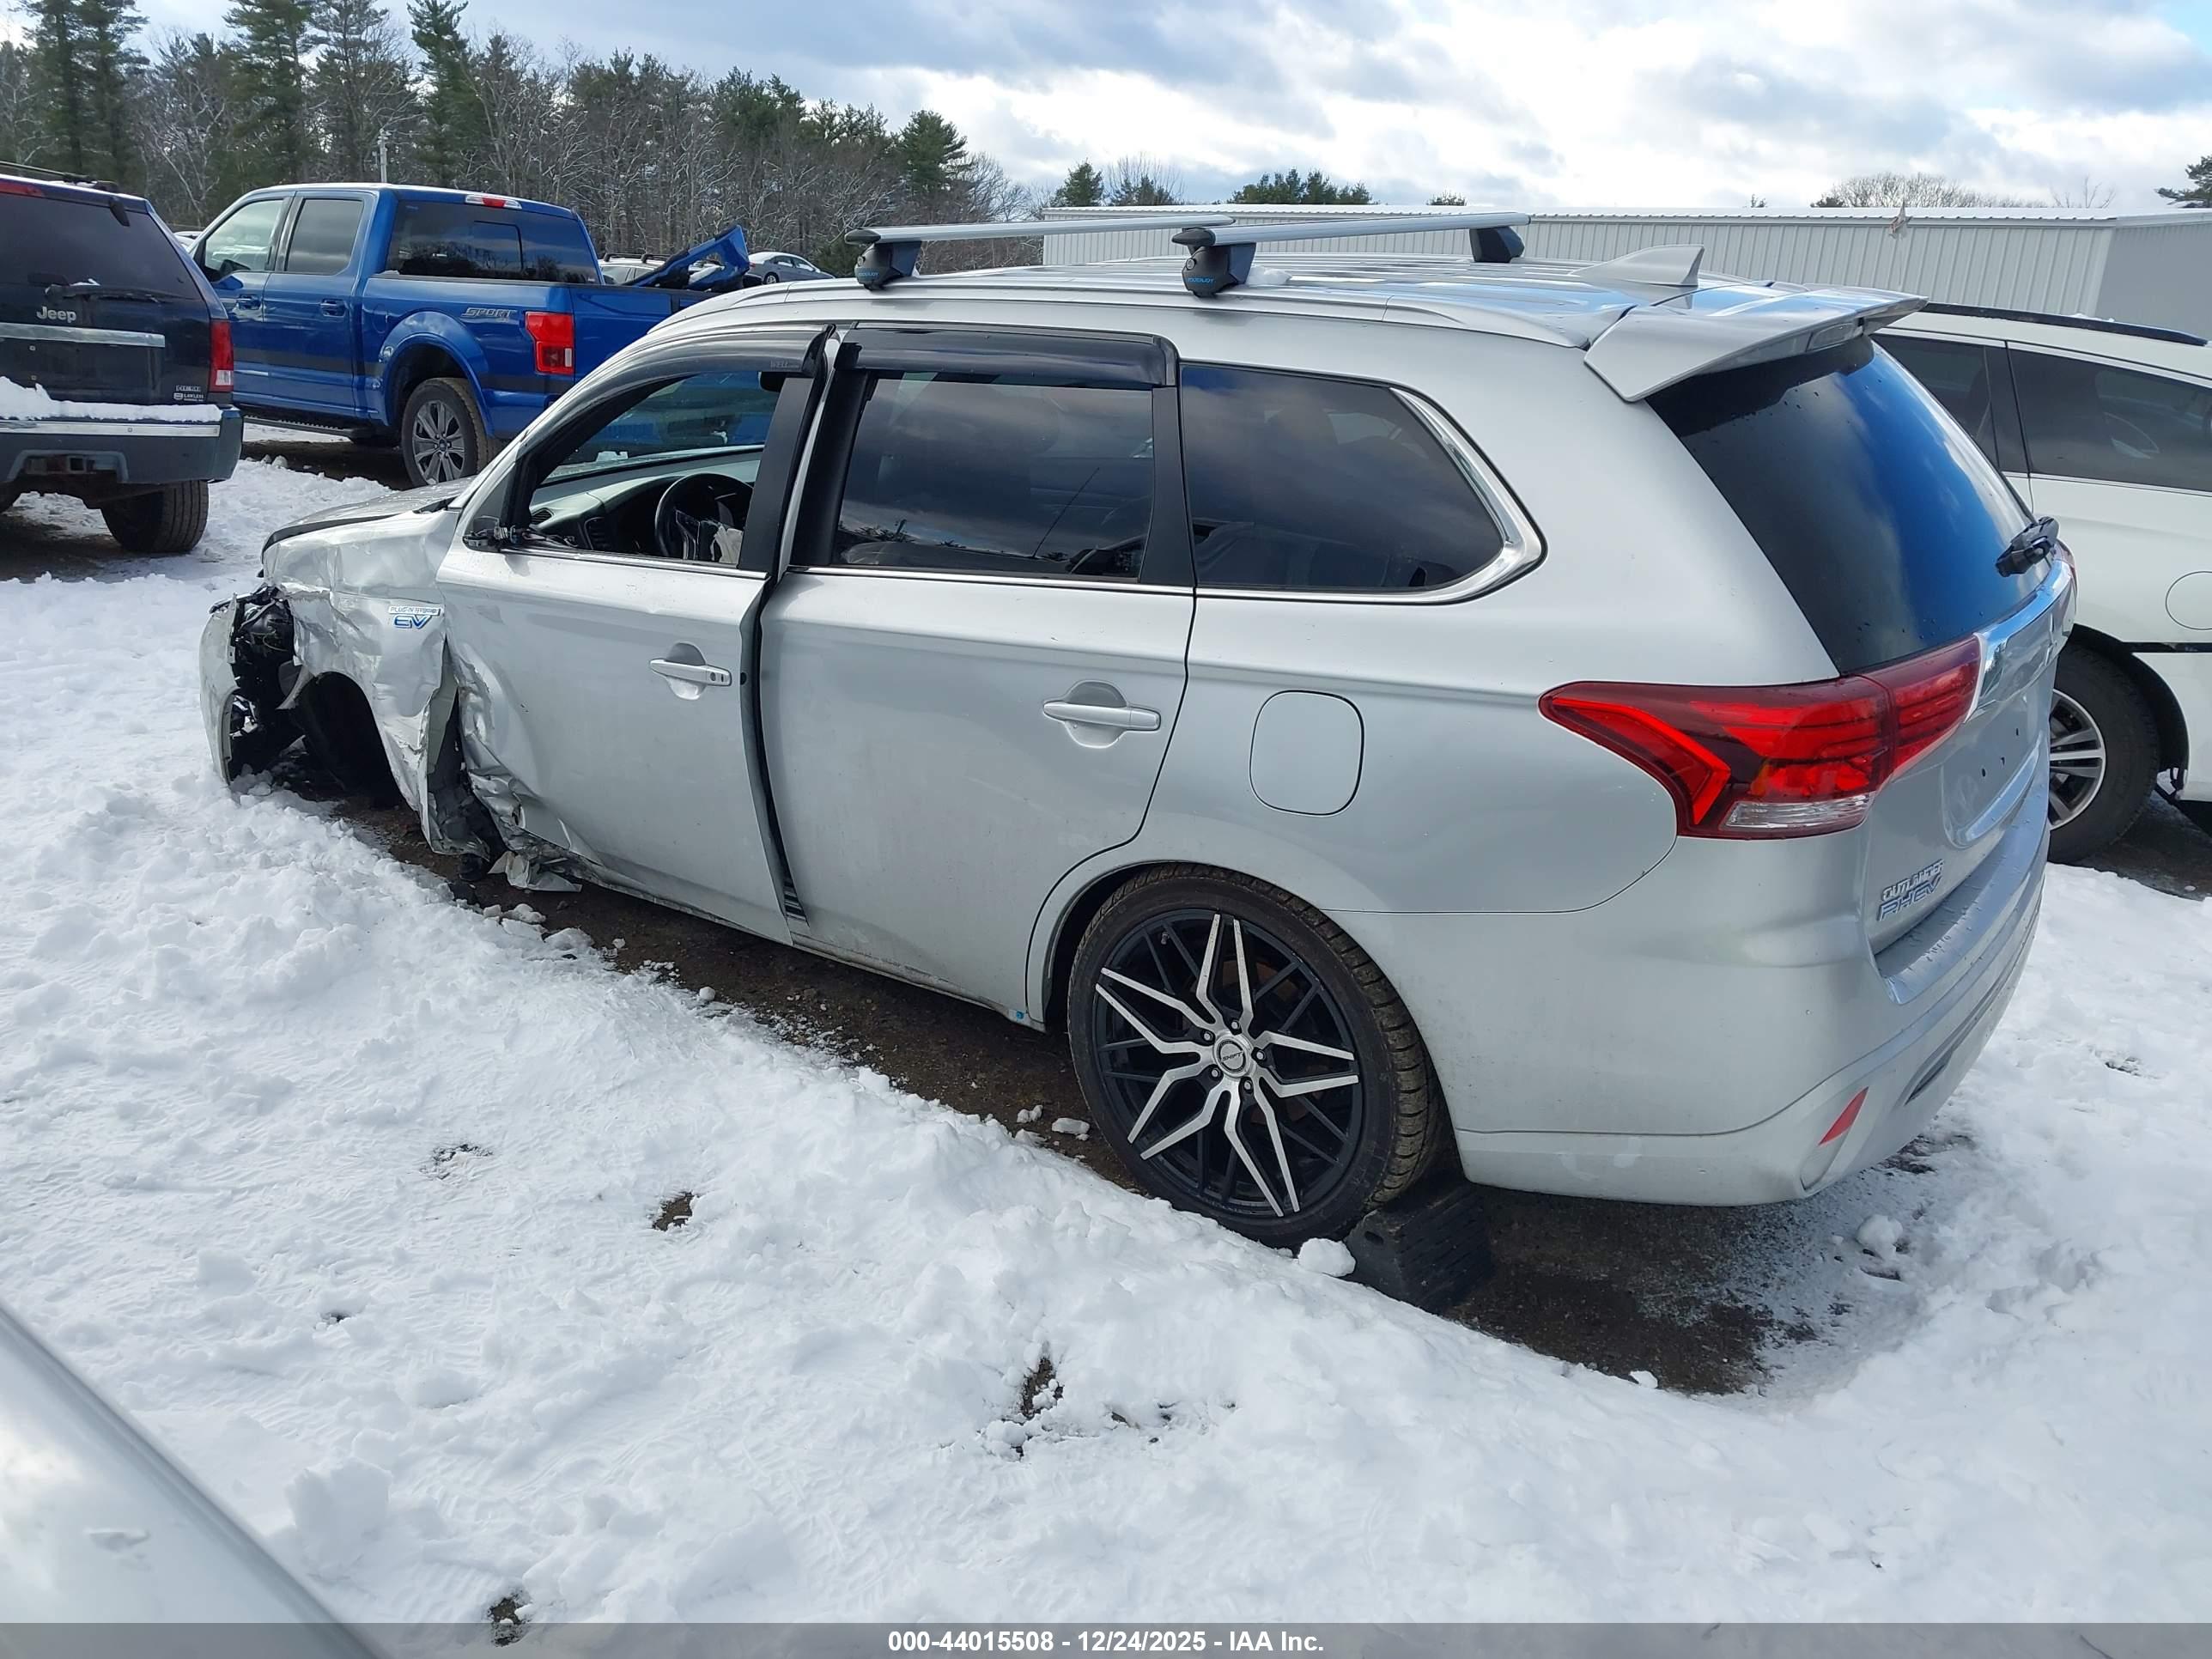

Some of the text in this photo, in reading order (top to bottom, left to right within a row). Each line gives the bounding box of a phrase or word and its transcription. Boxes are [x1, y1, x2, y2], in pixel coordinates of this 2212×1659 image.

[36, 306, 76, 323] Jeep
[460, 307, 518, 319] SPORT
[393, 614, 432, 629] EV
[1881, 859, 1944, 901] OUTLANDER
[1876, 874, 1942, 921] PHEV
